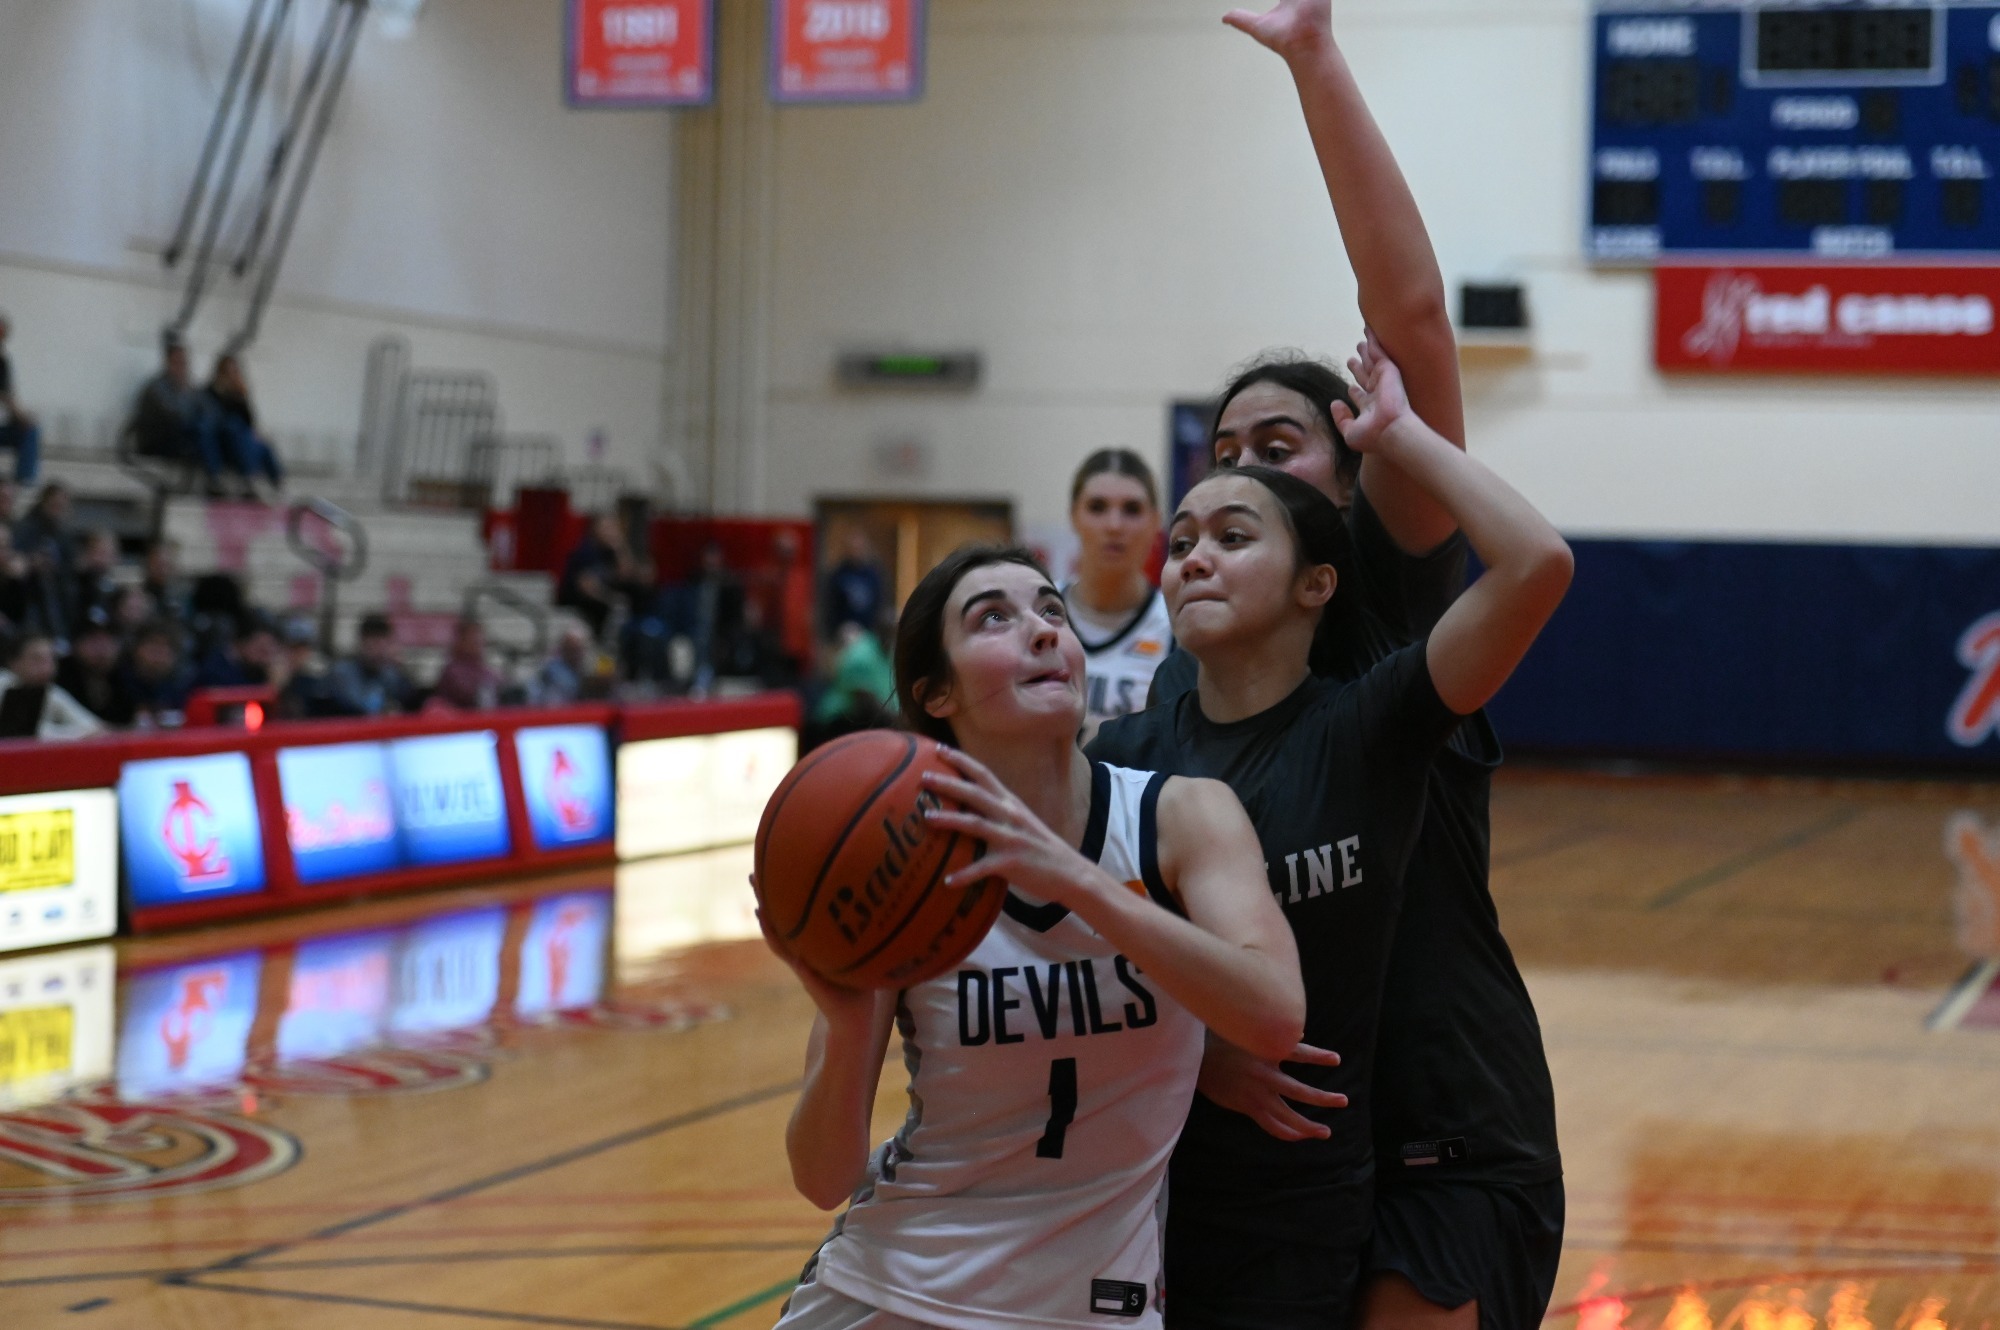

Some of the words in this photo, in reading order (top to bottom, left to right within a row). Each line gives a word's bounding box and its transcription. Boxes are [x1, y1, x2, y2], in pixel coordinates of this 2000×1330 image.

[957, 953, 1158, 1047] DEVILS
[1035, 1057, 1078, 1160] 1
[1448, 1146, 1458, 1158] L
[1130, 1293, 1139, 1307] S
